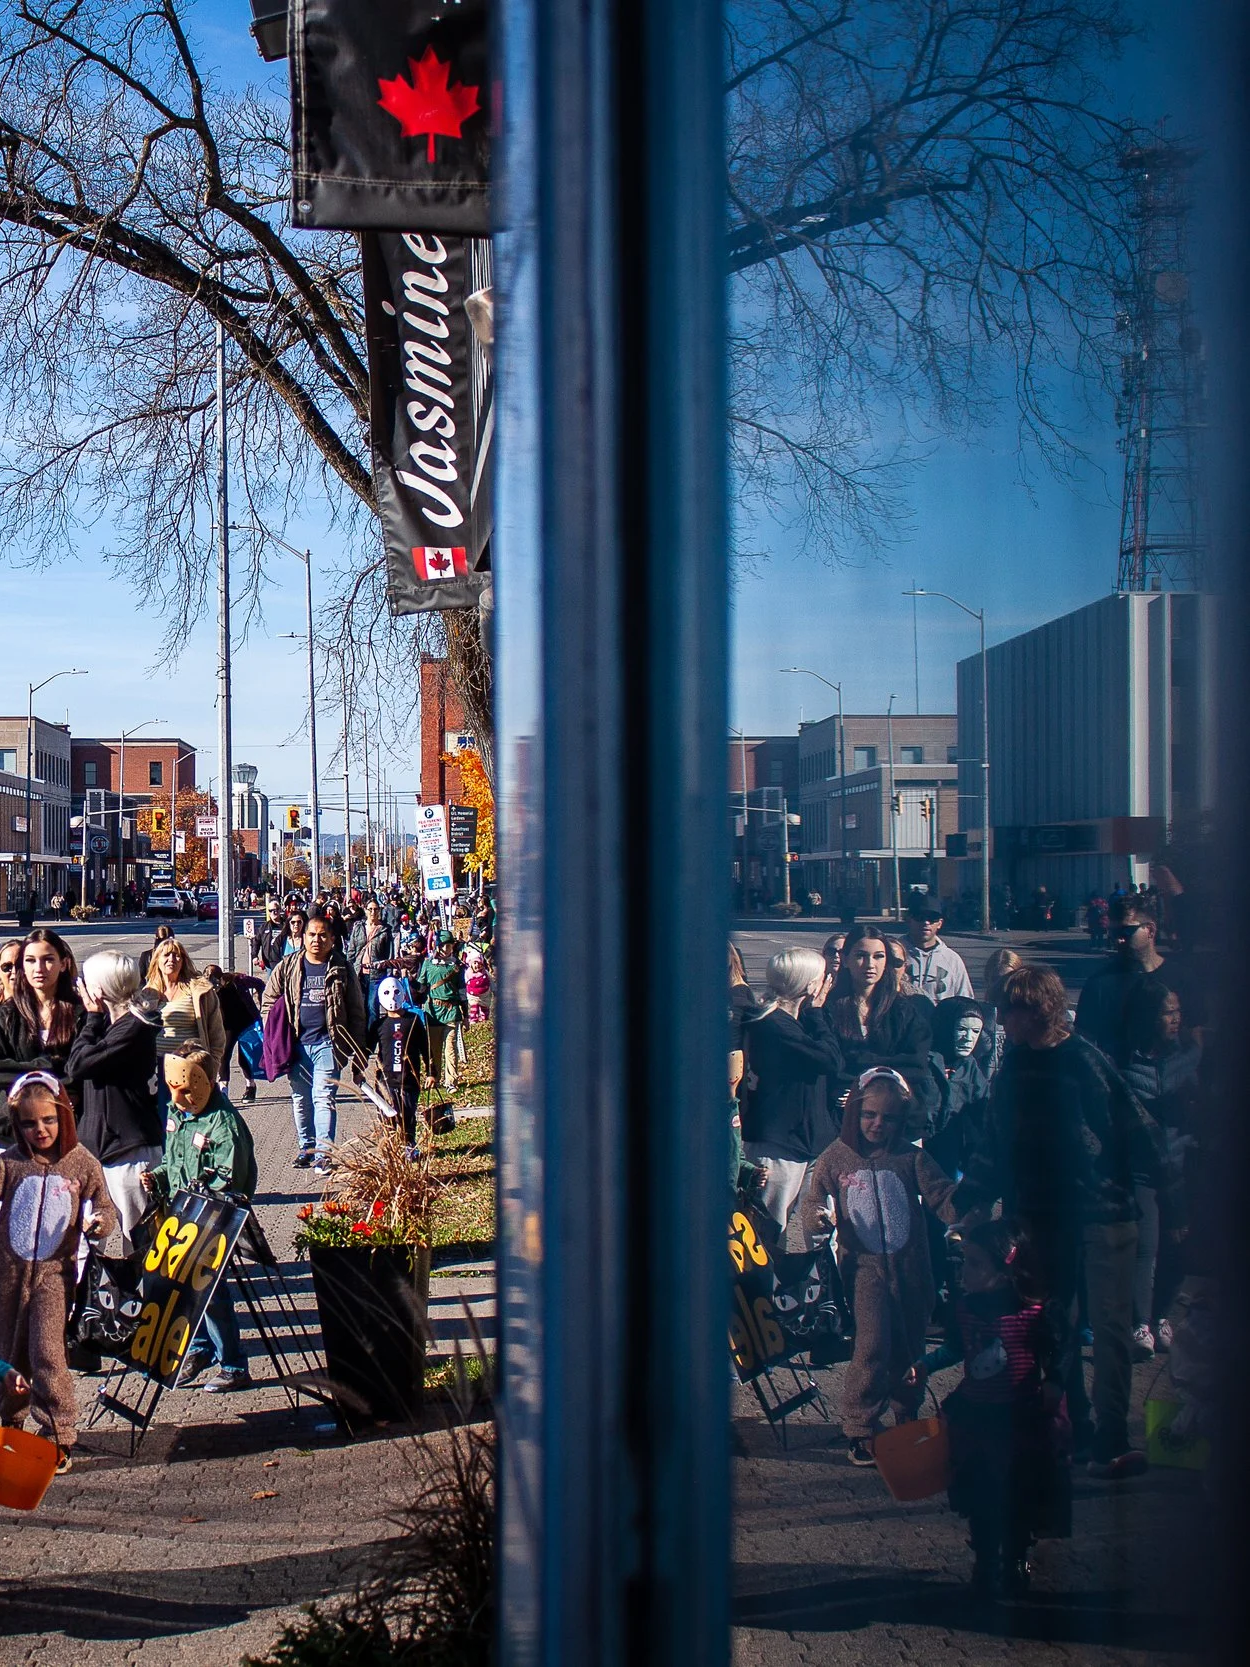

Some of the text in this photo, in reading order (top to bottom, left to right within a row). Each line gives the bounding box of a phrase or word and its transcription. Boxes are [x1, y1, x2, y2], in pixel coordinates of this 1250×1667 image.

[382, 233, 463, 528] Jasmine
[145, 1210, 227, 1291] sale
[131, 1288, 191, 1376] ale
